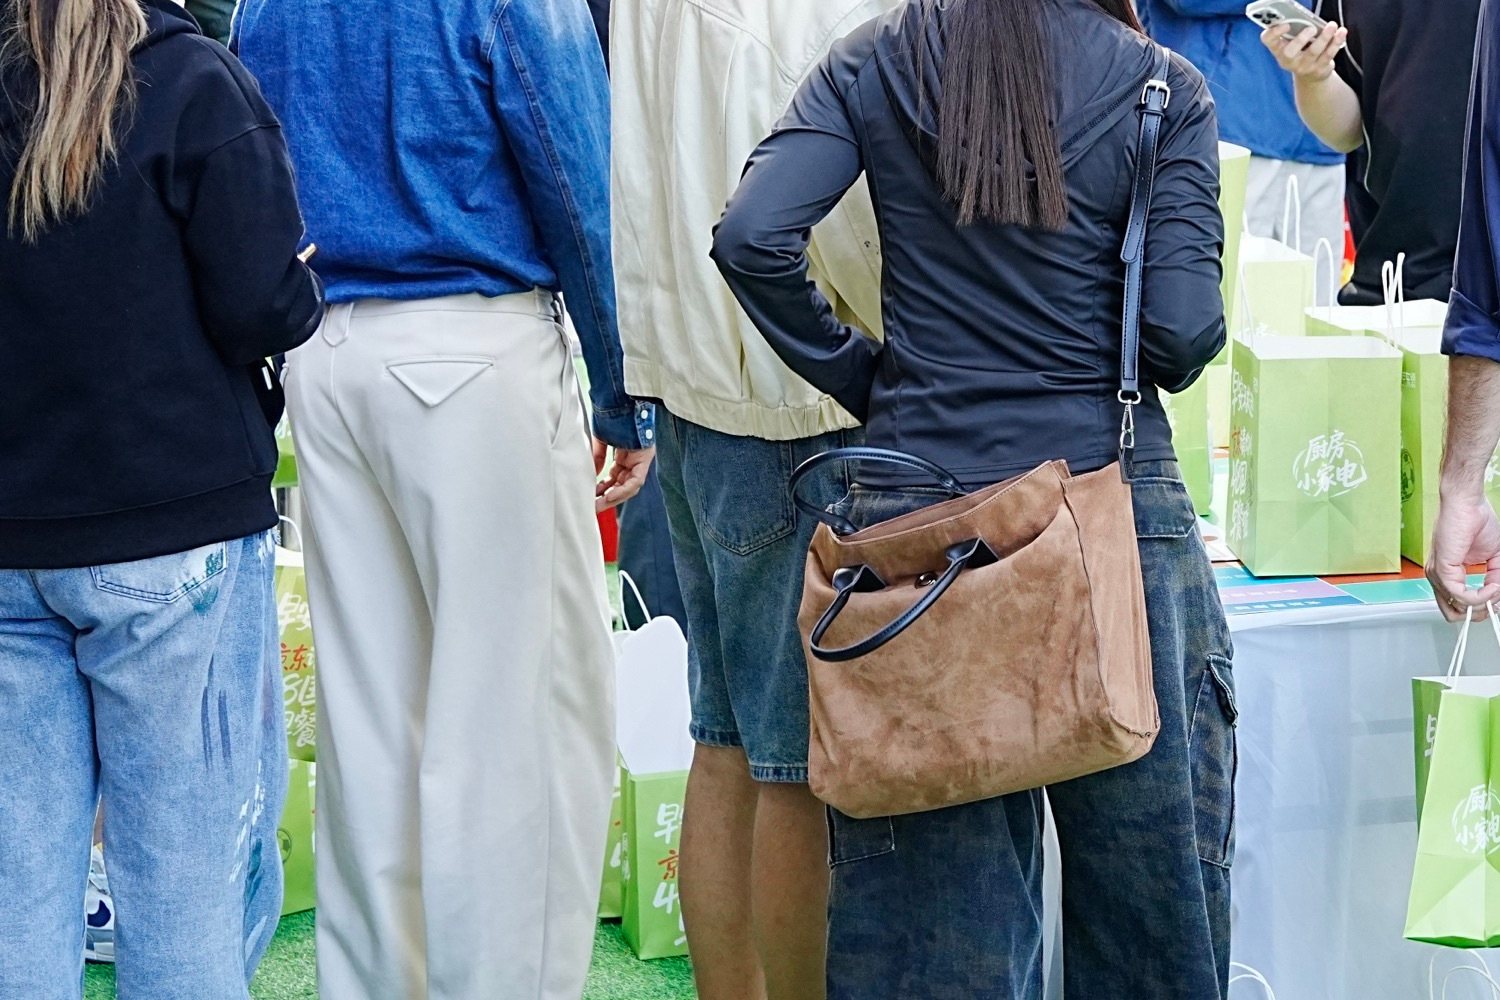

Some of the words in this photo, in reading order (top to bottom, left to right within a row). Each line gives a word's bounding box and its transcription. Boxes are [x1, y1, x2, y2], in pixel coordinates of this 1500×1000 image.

[1304, 430, 1345, 468] 厨房
[1297, 459, 1368, 497] 小家电
